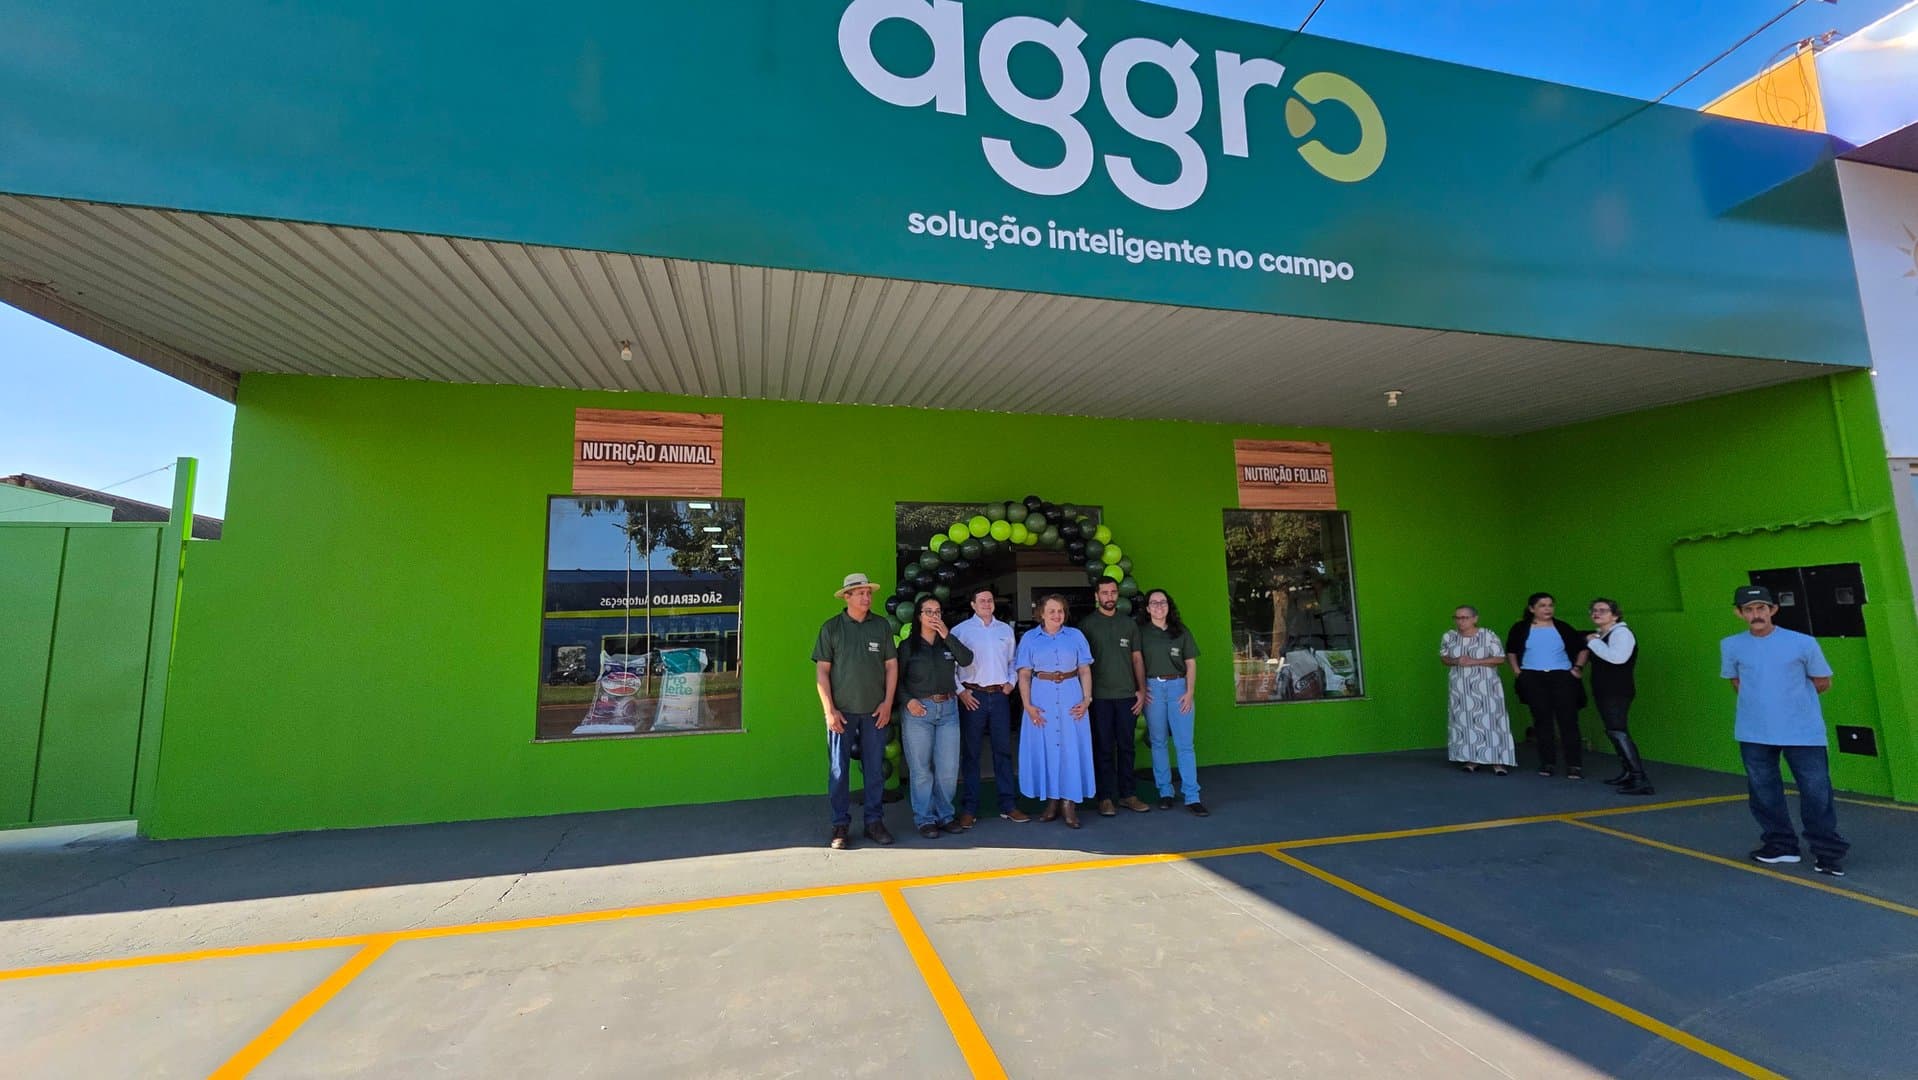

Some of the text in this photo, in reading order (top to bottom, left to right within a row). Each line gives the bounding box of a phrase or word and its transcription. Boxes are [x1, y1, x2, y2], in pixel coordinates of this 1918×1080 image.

[837, 0, 1388, 211] aggro
[907, 209, 1355, 283] solução inteligente no campo
[582, 441, 714, 465] NUTRIÇÃO ANIMAL
[1243, 465, 1328, 484] NUTRIÇÃO FOLIAR
